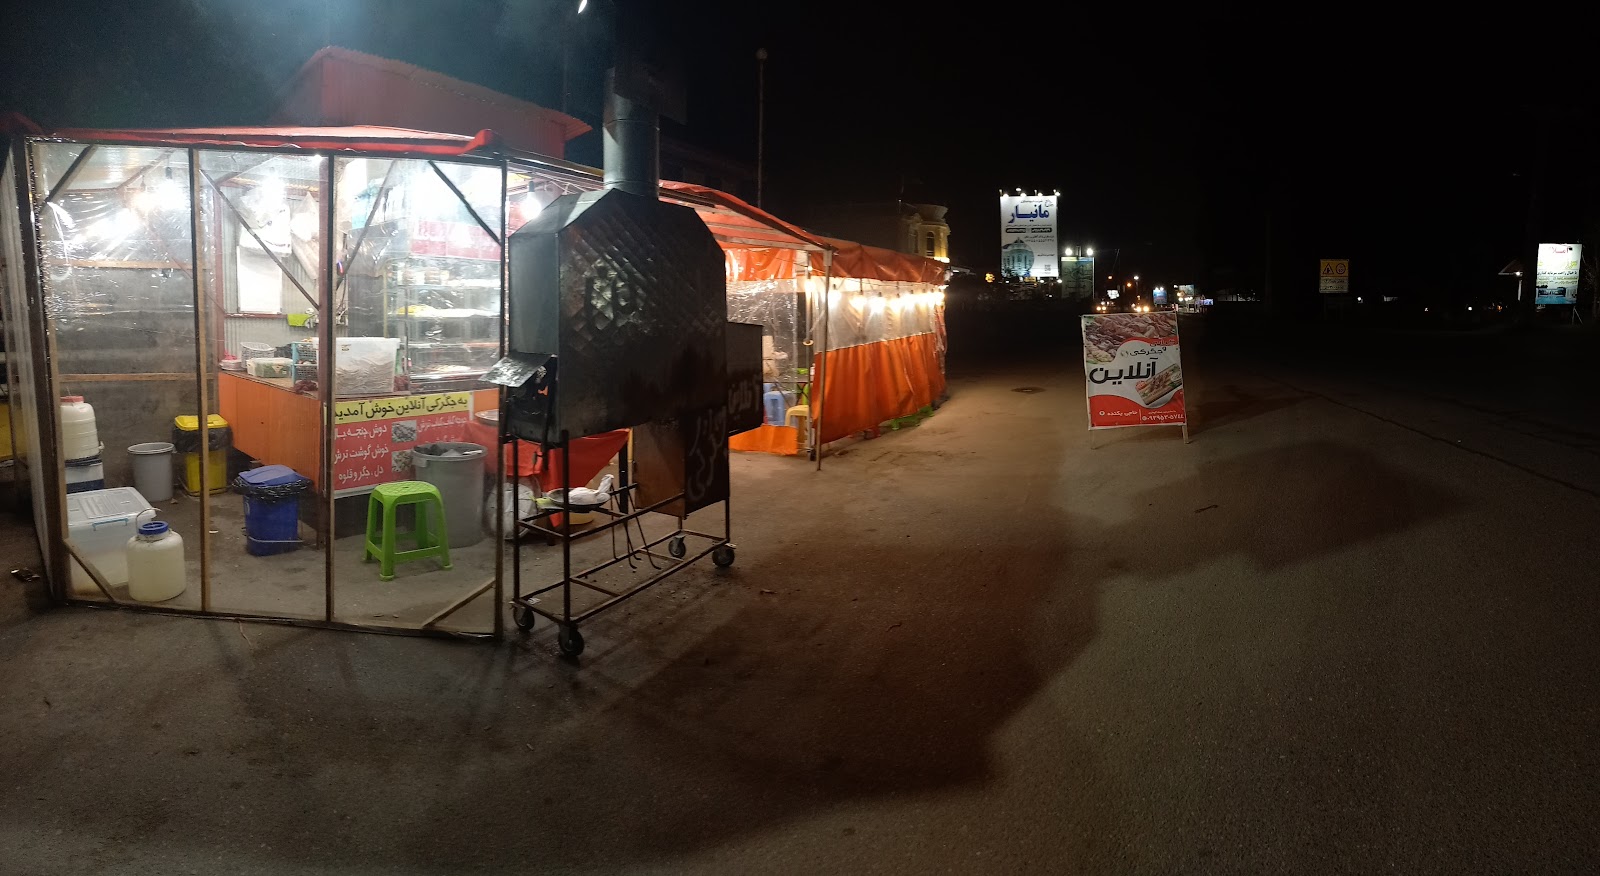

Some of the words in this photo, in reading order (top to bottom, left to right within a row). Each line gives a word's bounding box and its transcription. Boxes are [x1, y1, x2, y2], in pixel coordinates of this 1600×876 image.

[1007, 204, 1049, 224] مانیار
[1089, 357, 1158, 385] آنلاین
[365, 402, 394, 418] خوش
[396, 397, 426, 415] آنلاین
[426, 396, 457, 412] جگرکی
[457, 398, 468, 407] به
[350, 444, 371, 460] گوشت
